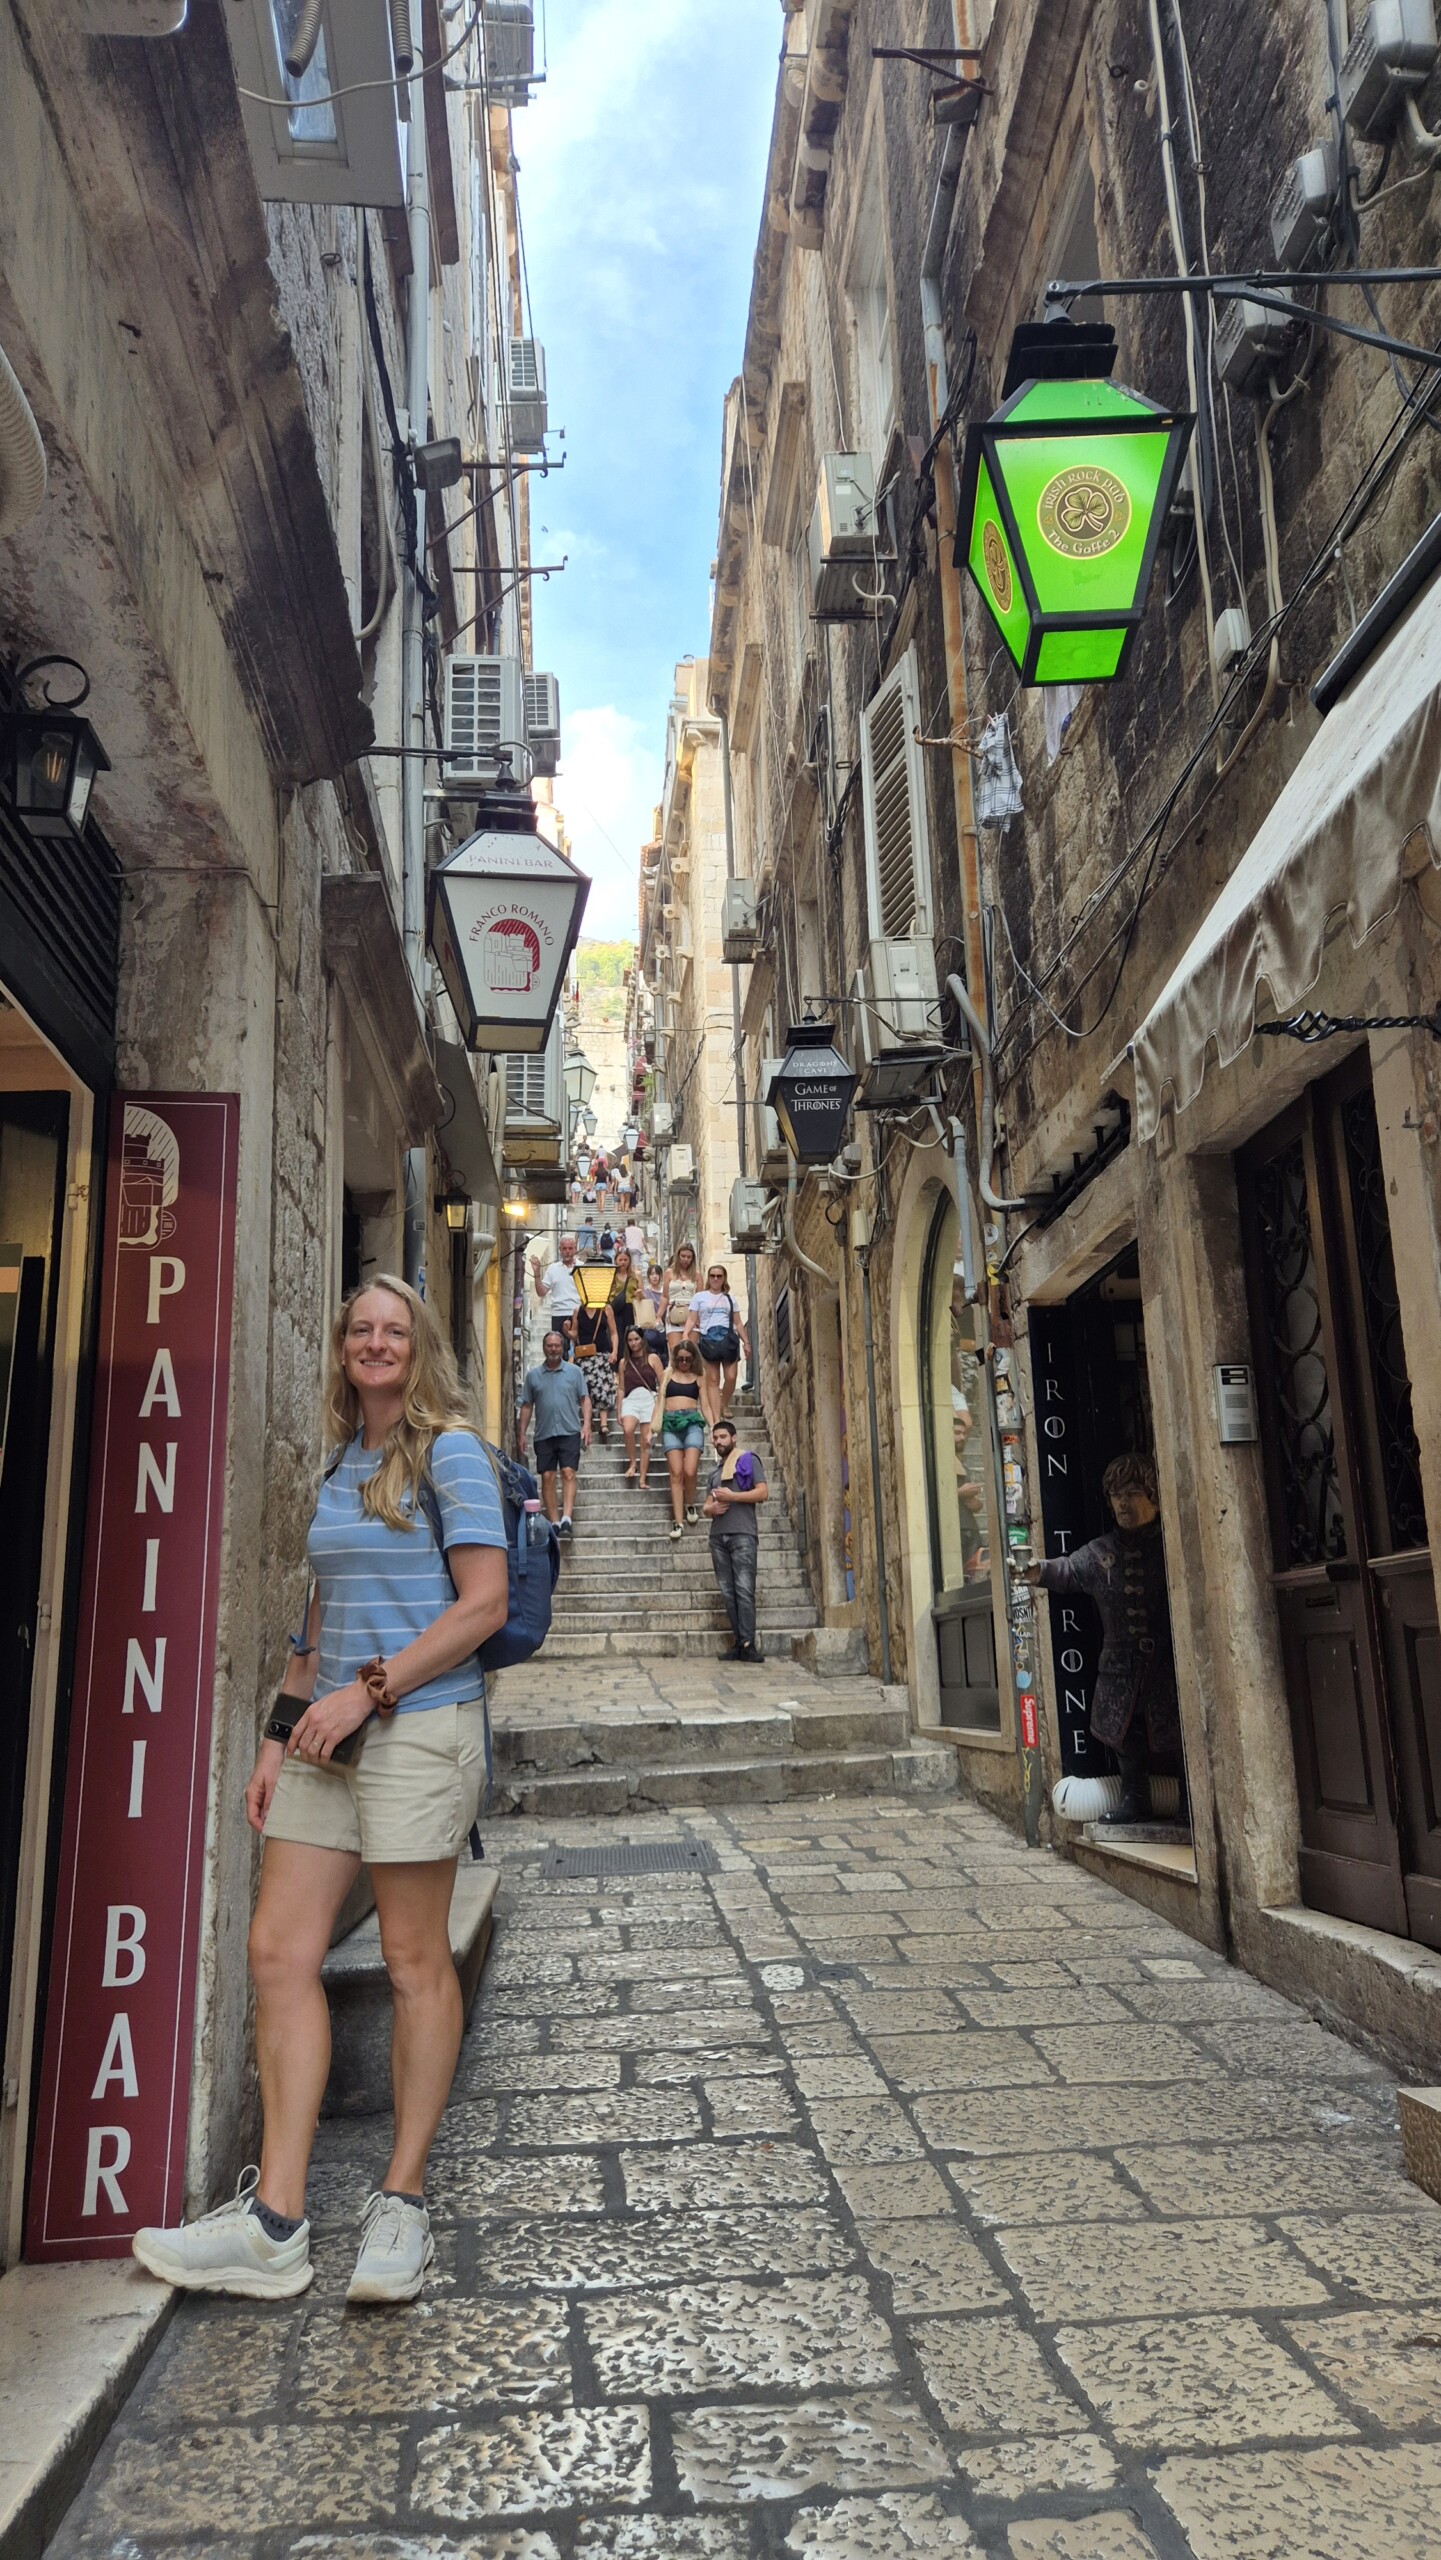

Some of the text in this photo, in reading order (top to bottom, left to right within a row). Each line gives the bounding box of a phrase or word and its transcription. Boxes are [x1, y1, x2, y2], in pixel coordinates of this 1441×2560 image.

[1048, 529, 1120, 554] The Gaffe 2
[469, 854, 553, 868] PANINI BAR
[469, 903, 555, 946] FRANCO ROMANO
[791, 1098, 842, 1112] THRONES
[794, 1082, 829, 1095] GAME
[1044, 1342, 1067, 1477] IRON
[81, 1255, 186, 2216] PANINI BAR
[1023, 1697, 1035, 1744] Supreme
